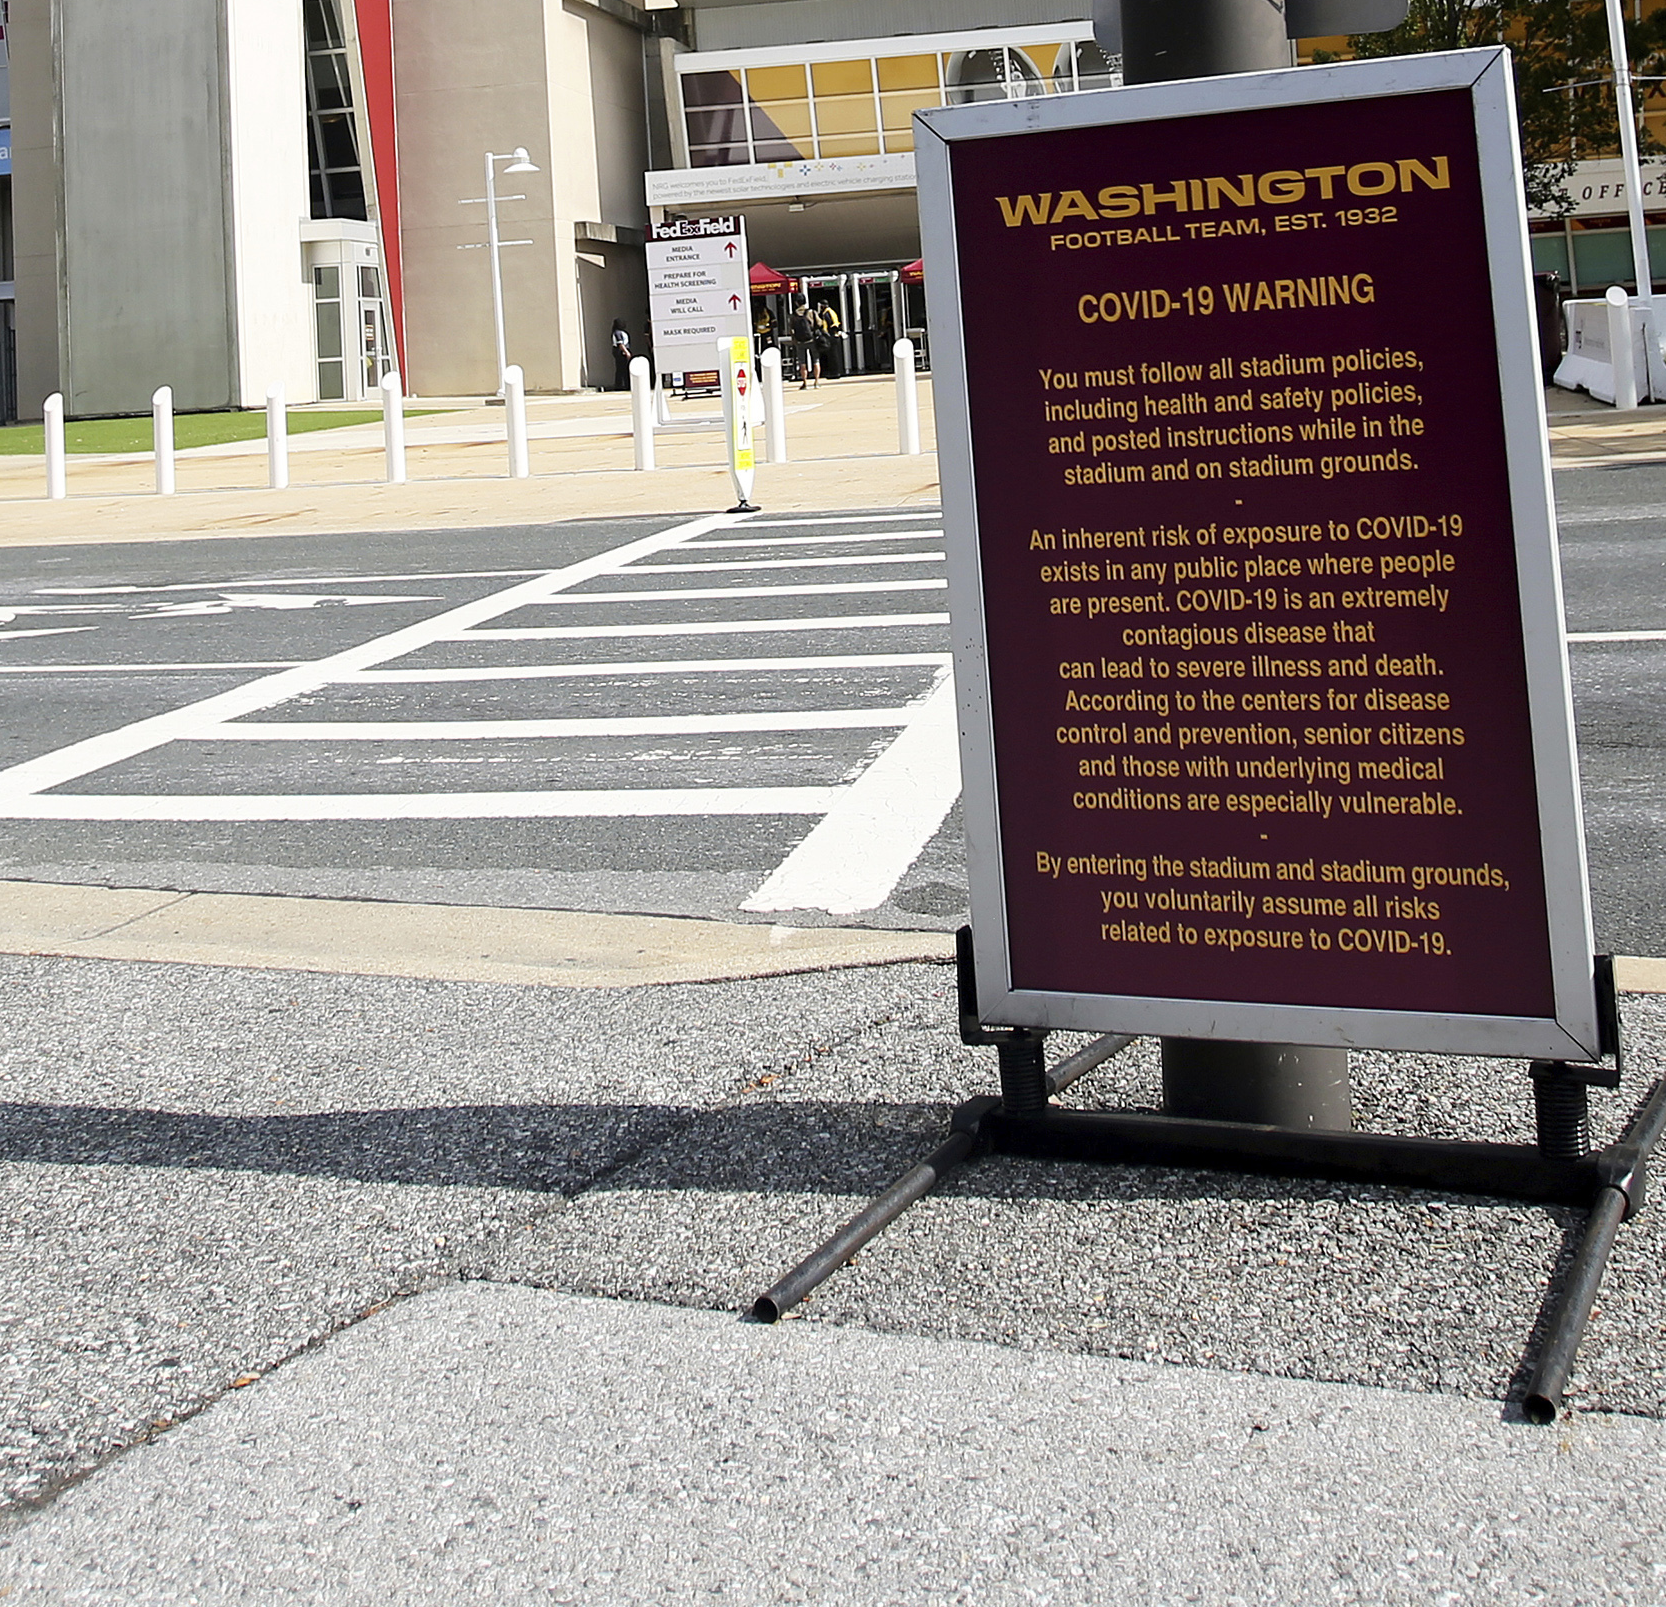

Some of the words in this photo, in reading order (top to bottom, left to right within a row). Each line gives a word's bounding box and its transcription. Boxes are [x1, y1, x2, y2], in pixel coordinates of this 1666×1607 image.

[996, 156, 1451, 227] WASHINGTON
[652, 216, 734, 239] FedExField
[1050, 225, 1181, 250] FOOTBALL
[1184, 218, 1267, 238] TEAM,
[1274, 212, 1327, 232] EST.
[1335, 206, 1398, 226] 1932
[666, 254, 700, 262] ENTRANCE
[671, 245, 693, 253] MEDIA
[654, 281, 679, 289] HEALTH
[680, 279, 716, 288] SCREENING
[1078, 285, 1214, 324] COVID-19
[1222, 273, 1375, 313] WARNING
[683, 326, 716, 335] REQUIRED
[1039, 369, 1078, 390] You
[1084, 365, 1136, 387] must
[1140, 362, 1203, 384] follow
[1209, 358, 1233, 380] all
[1240, 354, 1325, 378] stadium
[1331, 348, 1424, 378] policies,
[1044, 397, 1139, 423] including
[1144, 393, 1208, 416] health
[1214, 389, 1253, 413] and
[1260, 387, 1324, 413] safety
[1331, 381, 1423, 412] policies,
[1048, 431, 1086, 454] and
[1091, 427, 1161, 456] posted
[1167, 423, 1294, 447] instructions
[1298, 417, 1357, 441] while
[1362, 416, 1383, 437] in
[1388, 413, 1424, 436] the
[1064, 462, 1145, 485] stadium
[1151, 458, 1190, 482] and
[1195, 461, 1222, 480] on
[1229, 454, 1314, 478] stadium
[1320, 449, 1419, 480] grounds.
[1029, 530, 1056, 550] An
[1062, 527, 1147, 549] inherent
[1151, 524, 1191, 547] risk
[1196, 523, 1217, 546] of
[1222, 524, 1322, 548] exposure
[1327, 520, 1350, 541] to
[1356, 513, 1463, 540] COVID-19
[1040, 561, 1101, 583] exists
[1106, 560, 1125, 580] in
[1131, 562, 1167, 585] any
[1174, 556, 1238, 582] public
[1244, 555, 1302, 582] place
[1306, 553, 1374, 575] where
[1380, 549, 1455, 578] people
[1050, 597, 1082, 615] are
[1087, 592, 1170, 618] present.
[1176, 587, 1277, 612] COVID-19
[1283, 588, 1303, 610] is
[1308, 591, 1335, 610] an
[1341, 584, 1449, 612] extremely
[1122, 624, 1239, 651] contagious
[1244, 622, 1327, 644] disease
[1332, 620, 1376, 643] that
[1059, 661, 1095, 679] can
[1101, 657, 1144, 679] lead
[1149, 658, 1170, 679] to
[1176, 660, 1246, 678] severe
[1251, 655, 1322, 678] illness
[1328, 654, 1369, 677] and
[1375, 653, 1444, 677] death.
[1065, 689, 1170, 717] According
[1174, 691, 1196, 711] to
[1201, 690, 1236, 711] the
[1241, 690, 1322, 711] centers
[1326, 688, 1358, 711] for
[1364, 688, 1450, 711] disease
[1056, 723, 1128, 744] control
[1133, 722, 1172, 744] and
[1178, 722, 1297, 749] prevention,
[1303, 723, 1372, 745] senior
[1378, 722, 1465, 746] citizens
[1079, 755, 1117, 777] and
[1121, 756, 1180, 778] those
[1185, 756, 1229, 778] with
[1236, 756, 1351, 785] underlying
[1358, 757, 1444, 780] medical
[1073, 788, 1182, 811] conditions
[1187, 793, 1220, 811] are
[1226, 790, 1333, 818] especially
[1339, 791, 1463, 815] vulnerable.
[1036, 851, 1062, 878] By
[1067, 855, 1147, 882] entering
[1152, 854, 1184, 877] the
[1189, 856, 1271, 879] stadium
[1276, 859, 1315, 881] and
[1320, 860, 1406, 883] stadium
[1411, 863, 1510, 890] grounds,
[1100, 891, 1139, 913] you
[1144, 888, 1256, 918] voluntarily
[1262, 896, 1347, 917] assume
[1353, 895, 1378, 917] all
[1385, 896, 1440, 920] risks
[1101, 920, 1171, 944] related
[1176, 923, 1198, 945] to
[1204, 927, 1304, 951] exposure
[1309, 928, 1331, 951] to
[1338, 927, 1452, 955] COVID-19.
